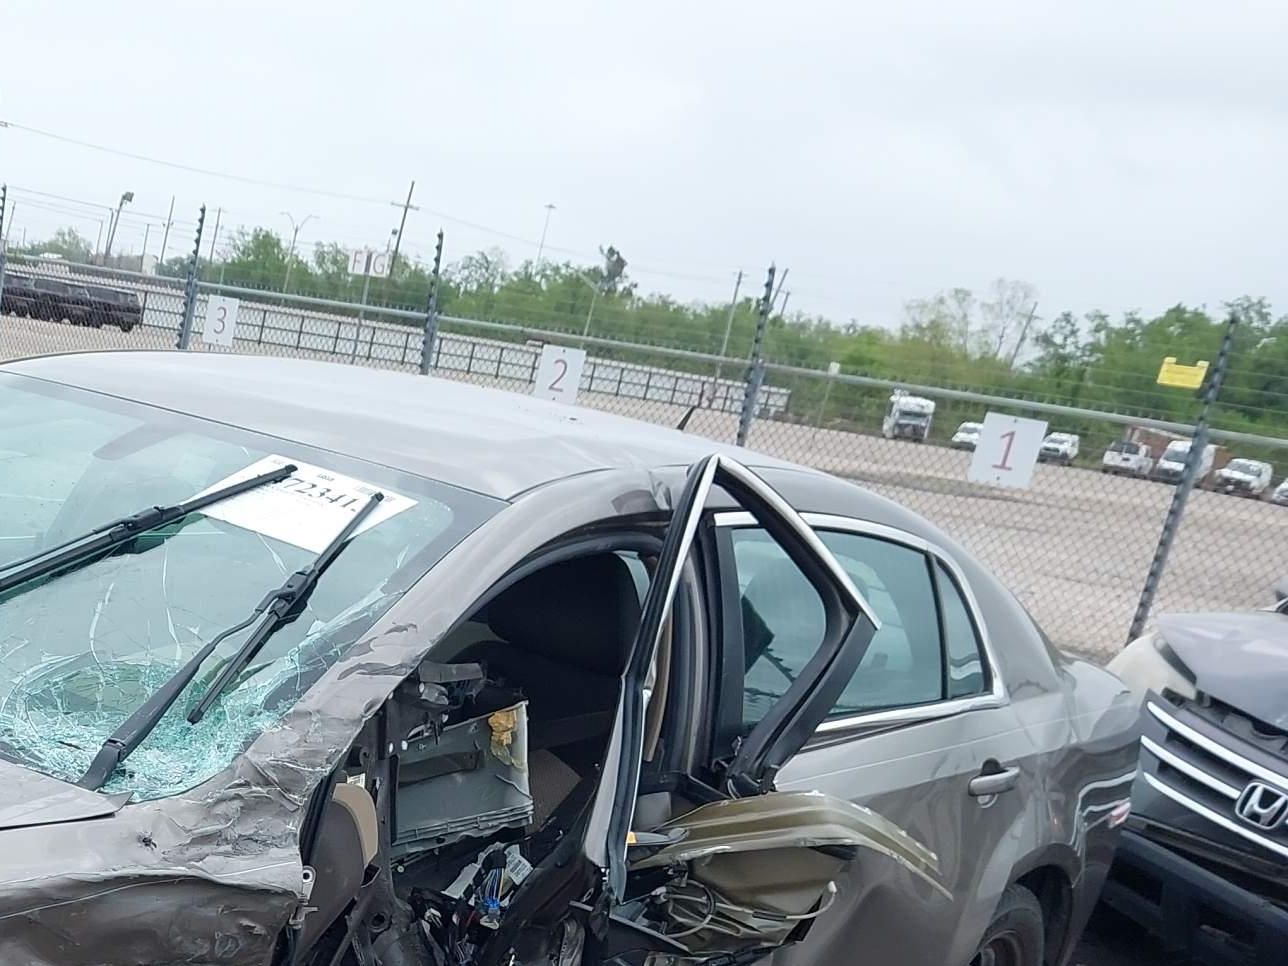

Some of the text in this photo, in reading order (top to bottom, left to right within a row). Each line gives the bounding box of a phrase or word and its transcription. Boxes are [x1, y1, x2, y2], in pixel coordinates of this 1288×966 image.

[351, 250, 386, 275] F G
[213, 306, 228, 335] 3
[548, 358, 568, 393] 2
[991, 430, 1017, 471] 1
[275, 475, 358, 513] 72341
